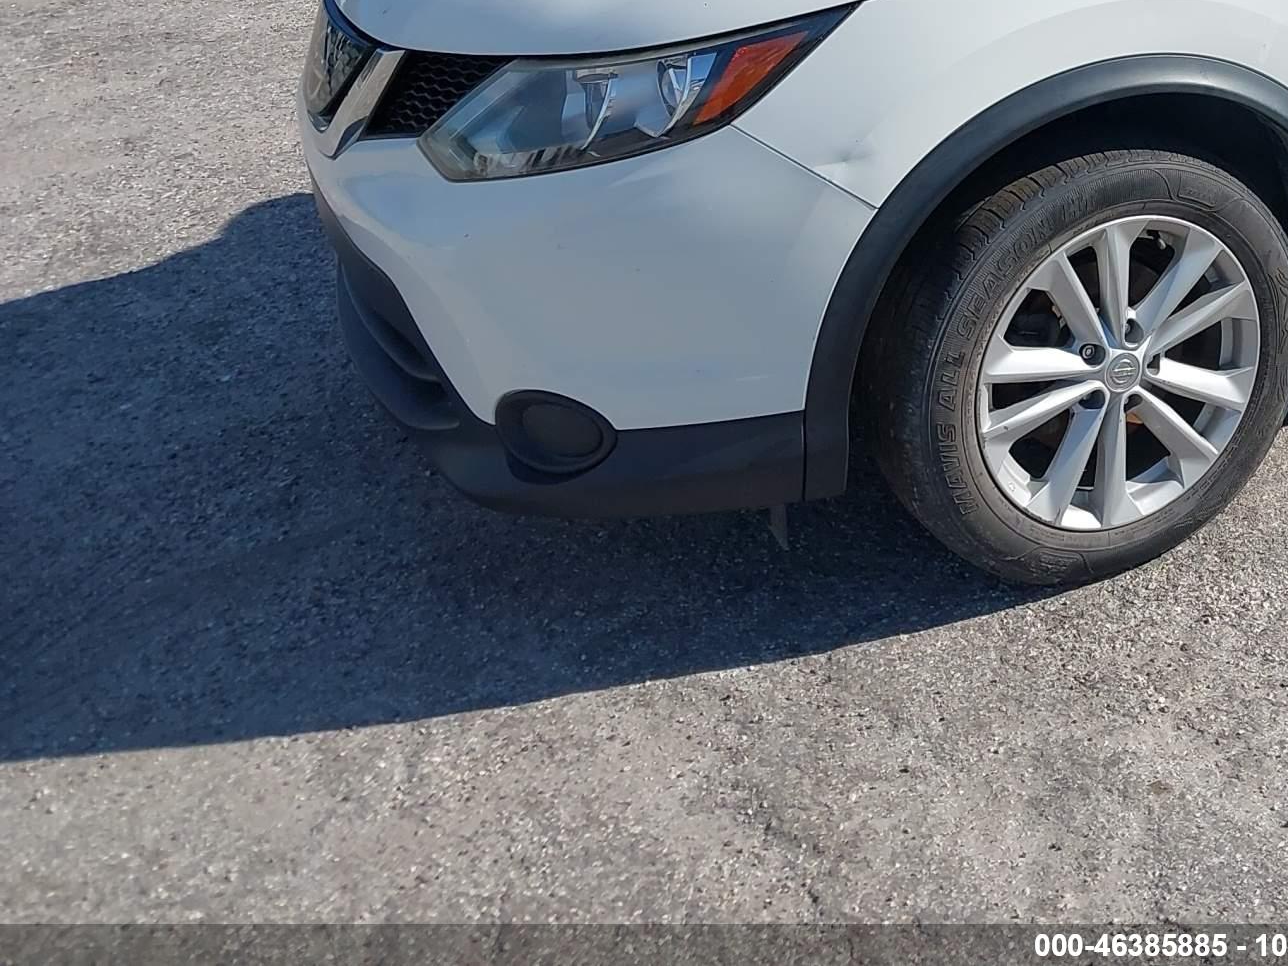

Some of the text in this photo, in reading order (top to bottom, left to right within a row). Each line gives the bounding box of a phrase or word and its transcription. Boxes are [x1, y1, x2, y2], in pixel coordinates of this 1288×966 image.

[956, 221, 1055, 341] SEASON
[937, 351, 966, 412] ALL
[936, 422, 979, 516] MAVIS
